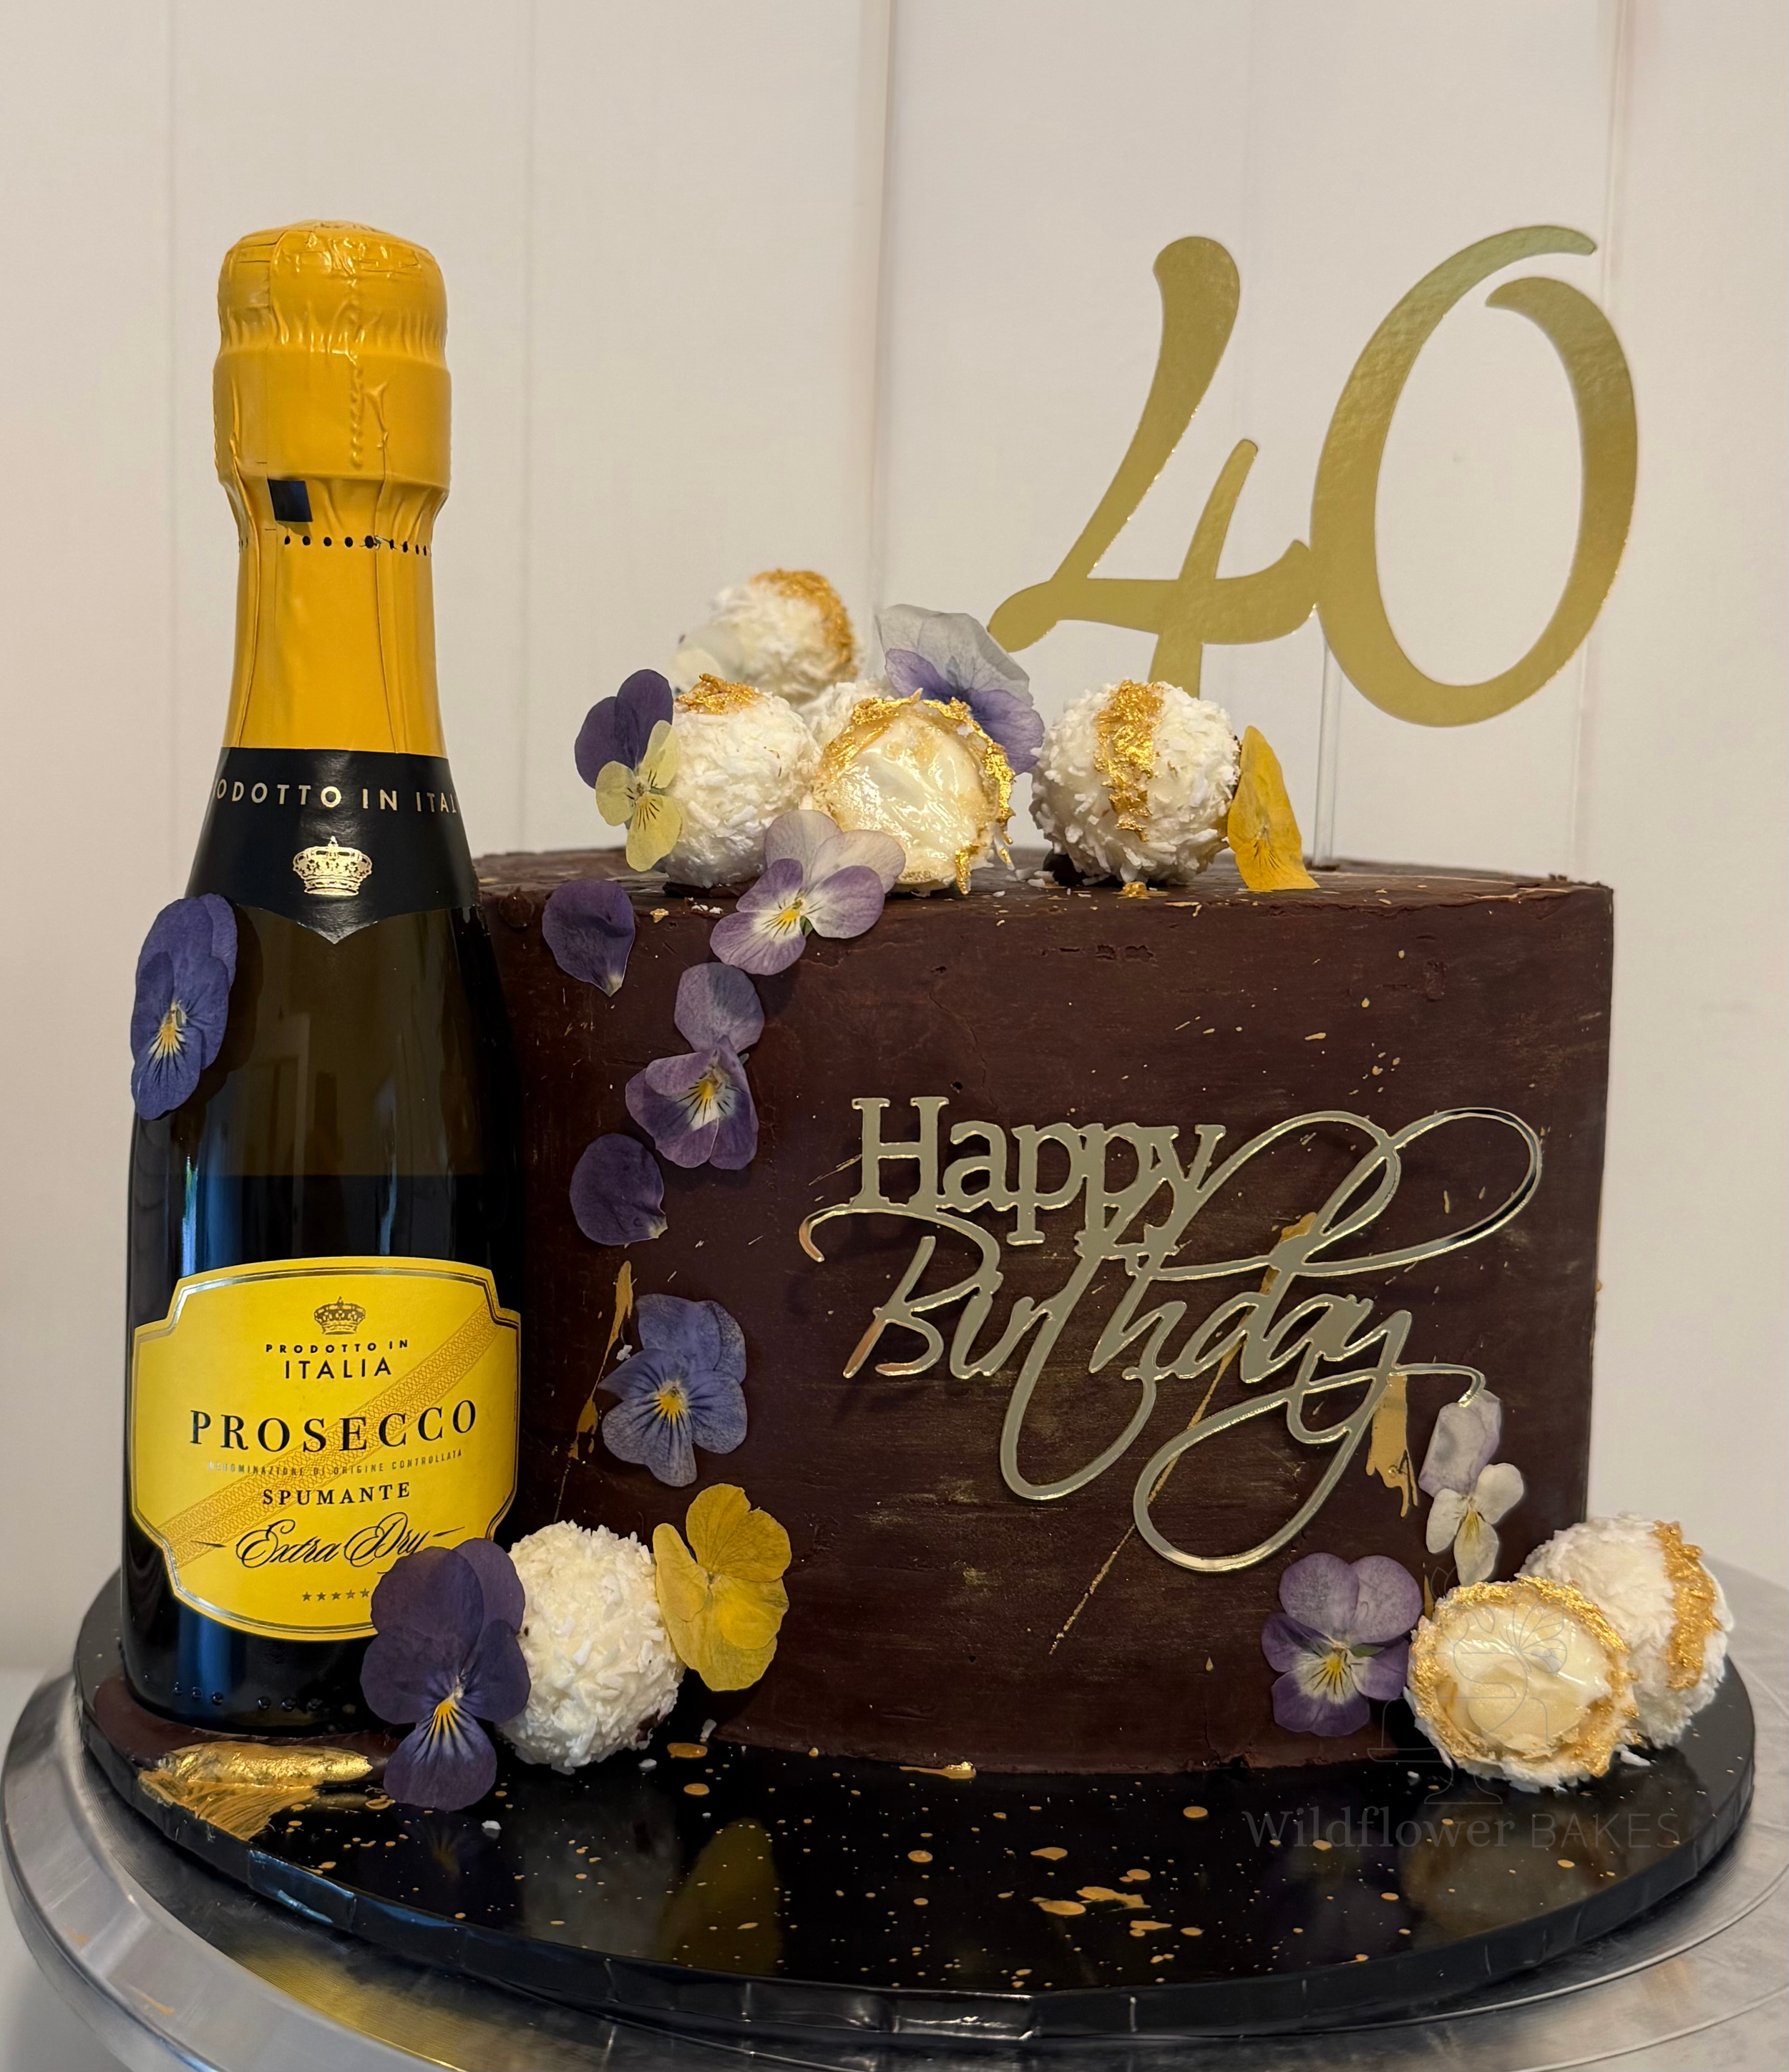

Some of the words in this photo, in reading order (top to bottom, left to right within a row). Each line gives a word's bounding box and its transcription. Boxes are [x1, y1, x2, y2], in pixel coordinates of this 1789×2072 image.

[987, 225, 1638, 727] 40
[362, 788, 398, 811] IN
[851, 1096, 1226, 1258] Happy
[265, 1342, 377, 1354] PRODOTTO
[389, 1339, 409, 1350] IN
[799, 1107, 1541, 1572] Birthday
[285, 1357, 392, 1379] ITALIA
[190, 1399, 477, 1452] PROSECCO
[313, 1467, 326, 1476] DI
[333, 1462, 384, 1475] ORIGINE
[391, 1449, 462, 1470] CONTROLLATA
[263, 1482, 411, 1505] SPUMANTE
[235, 1519, 342, 1568] Extra
[343, 1511, 431, 1573] Dry
